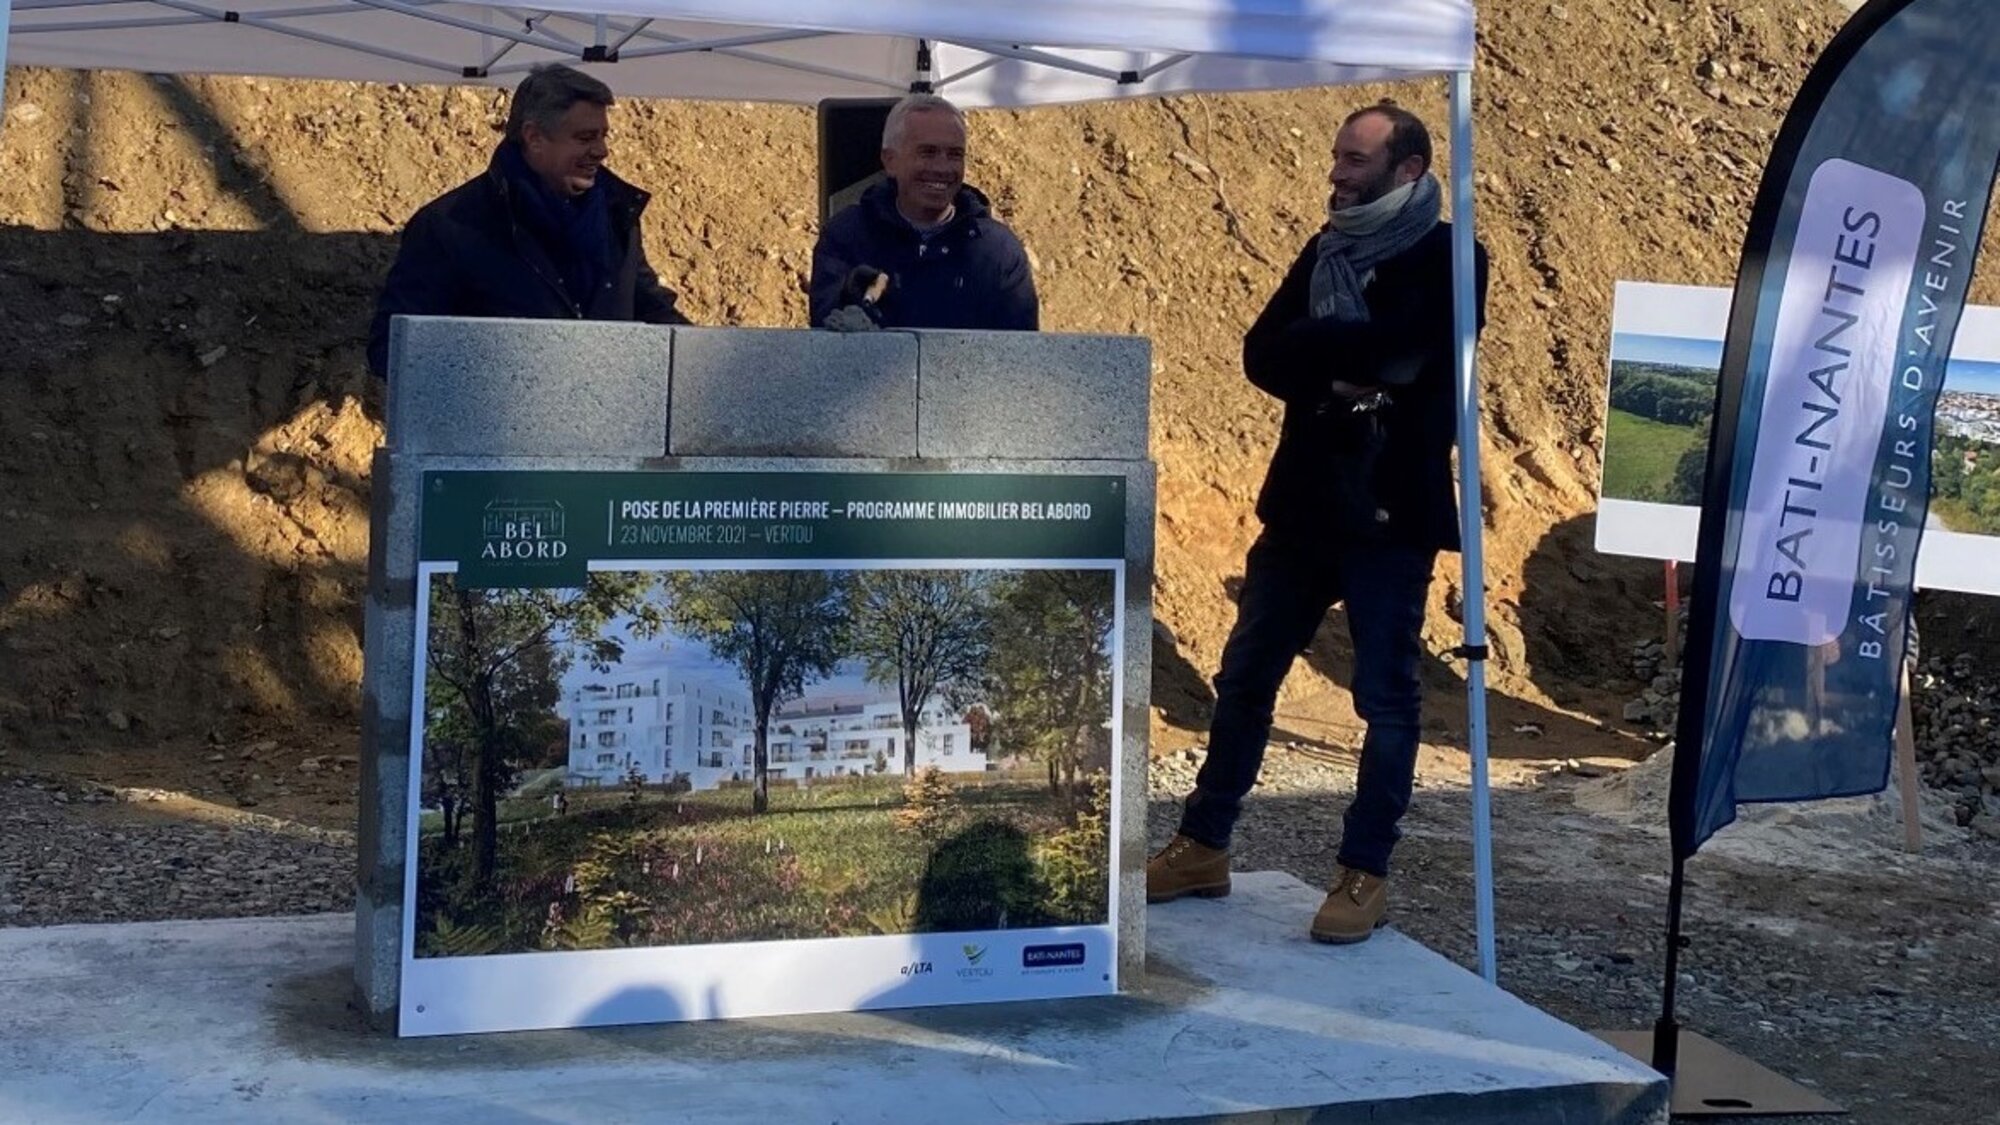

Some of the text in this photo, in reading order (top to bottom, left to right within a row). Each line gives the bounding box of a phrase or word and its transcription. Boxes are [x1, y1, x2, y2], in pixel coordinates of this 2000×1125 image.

[1766, 206, 1881, 603] BATI-NANTES
[1858, 198, 1967, 660] BÂTISSEURS D'AVENIR
[622, 500, 659, 519] POSE
[662, 500, 681, 519] DE
[684, 500, 701, 519] LA
[704, 497, 777, 520] PREMIÈRE
[780, 501, 829, 519] PIERRE
[847, 501, 935, 519] PROGRAMME
[938, 501, 1019, 520] IMMOBILIER
[1021, 502, 1045, 520] BEL
[1046, 502, 1091, 520] ABORD
[505, 521, 546, 540] BEL
[621, 524, 638, 544] 23
[641, 524, 713, 544] NOVEMBRE
[716, 524, 746, 544] 2021
[765, 525, 813, 544] VERTOU
[481, 540, 567, 559] ABORD
